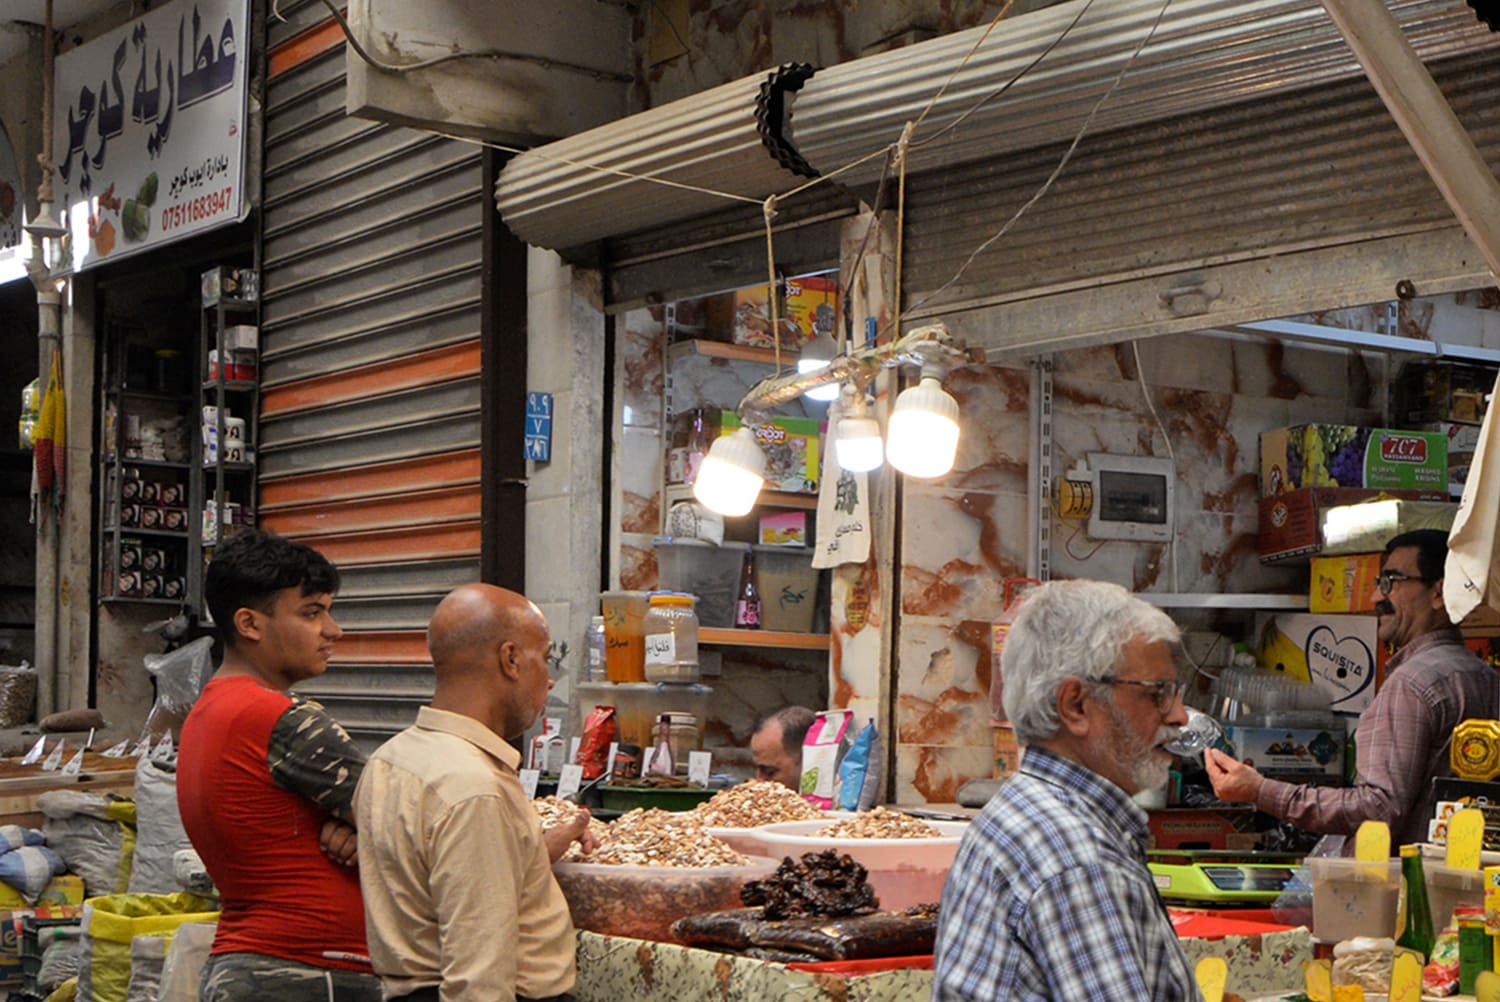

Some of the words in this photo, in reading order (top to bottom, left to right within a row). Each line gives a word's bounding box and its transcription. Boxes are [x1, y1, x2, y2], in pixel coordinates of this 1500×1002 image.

[161, 187, 232, 232] 07511683947
[533, 418, 543, 433] ٧
[1312, 641, 1363, 677] SQUISITA
